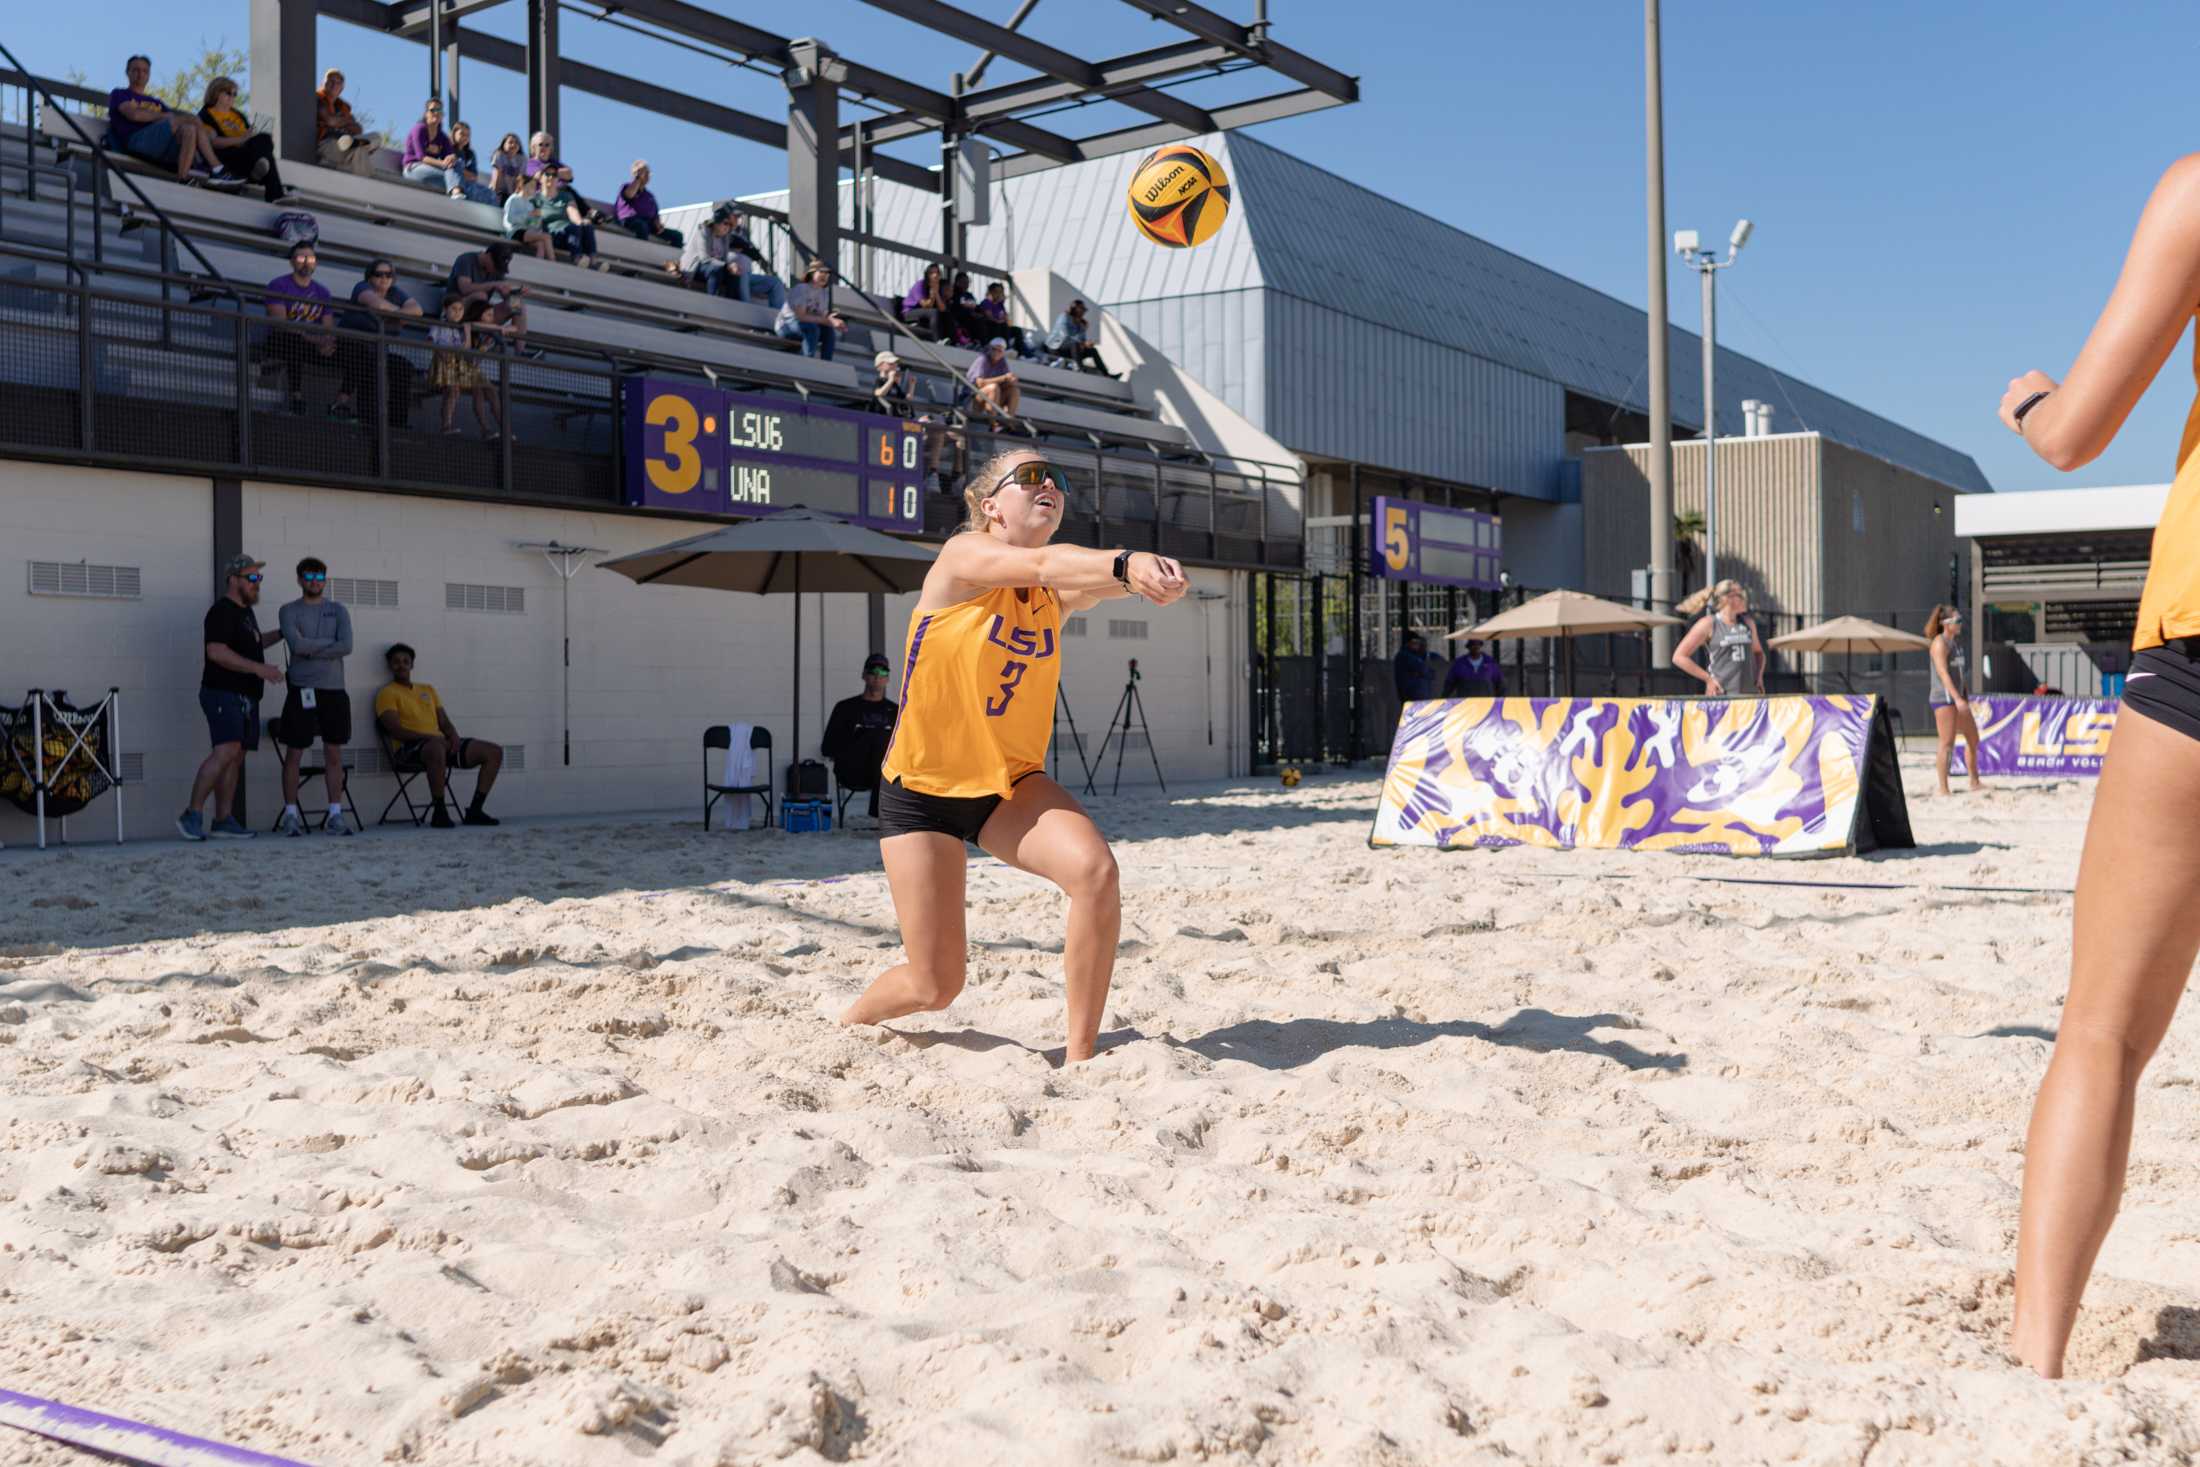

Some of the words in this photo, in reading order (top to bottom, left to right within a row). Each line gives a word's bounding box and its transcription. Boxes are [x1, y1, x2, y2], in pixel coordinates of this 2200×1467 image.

[1145, 166, 1185, 202] Wilson
[1178, 177, 1198, 196] NCAA
[645, 394, 701, 494] 3
[729, 409, 783, 451] LSU6
[880, 433, 895, 466] 6
[903, 436, 917, 468] 0
[730, 464, 771, 504] UNA
[888, 486, 895, 514] 1
[903, 486, 917, 519] 0
[1385, 507, 1409, 570] 5
[1732, 645, 1745, 661] 21
[986, 660, 1028, 716] 3
[2020, 712, 2117, 756] LS
[2017, 756, 2065, 767] BEACH
